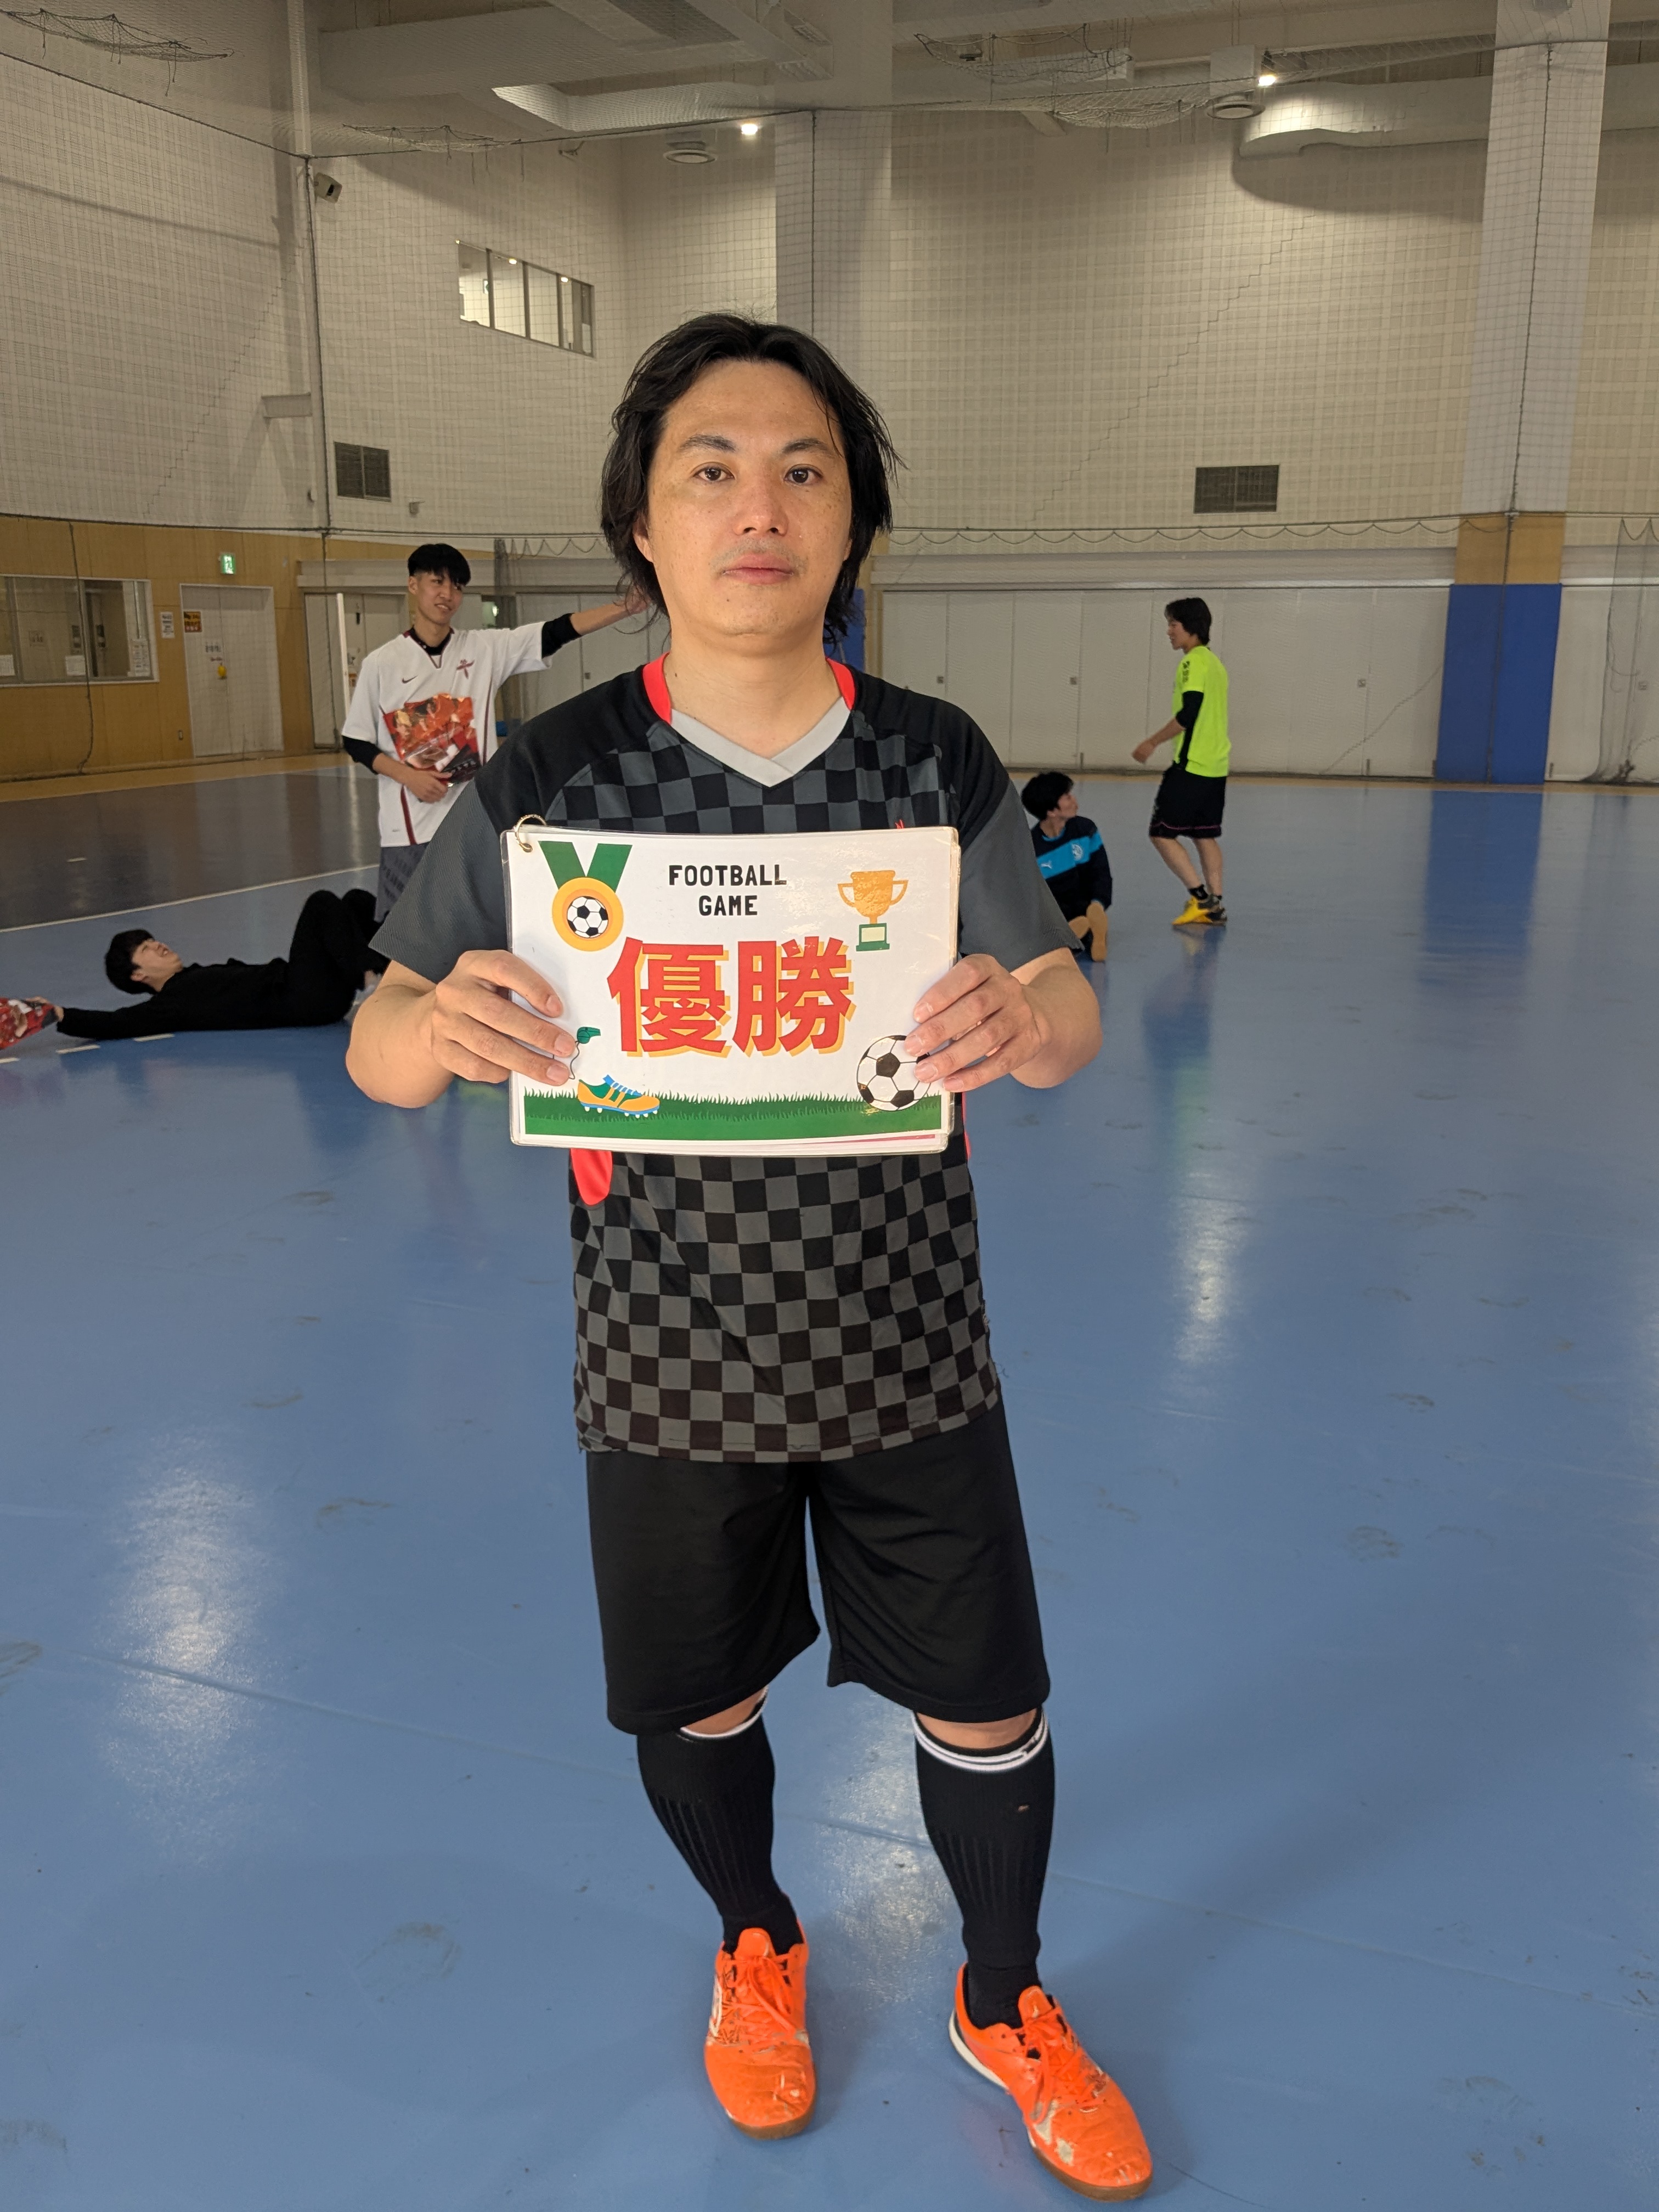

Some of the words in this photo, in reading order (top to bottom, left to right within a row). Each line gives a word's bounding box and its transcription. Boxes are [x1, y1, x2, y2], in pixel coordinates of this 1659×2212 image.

[668, 864, 787, 887] FOOTBALL
[698, 895, 758, 916] GAME
[607, 936, 855, 1058] 優勝
